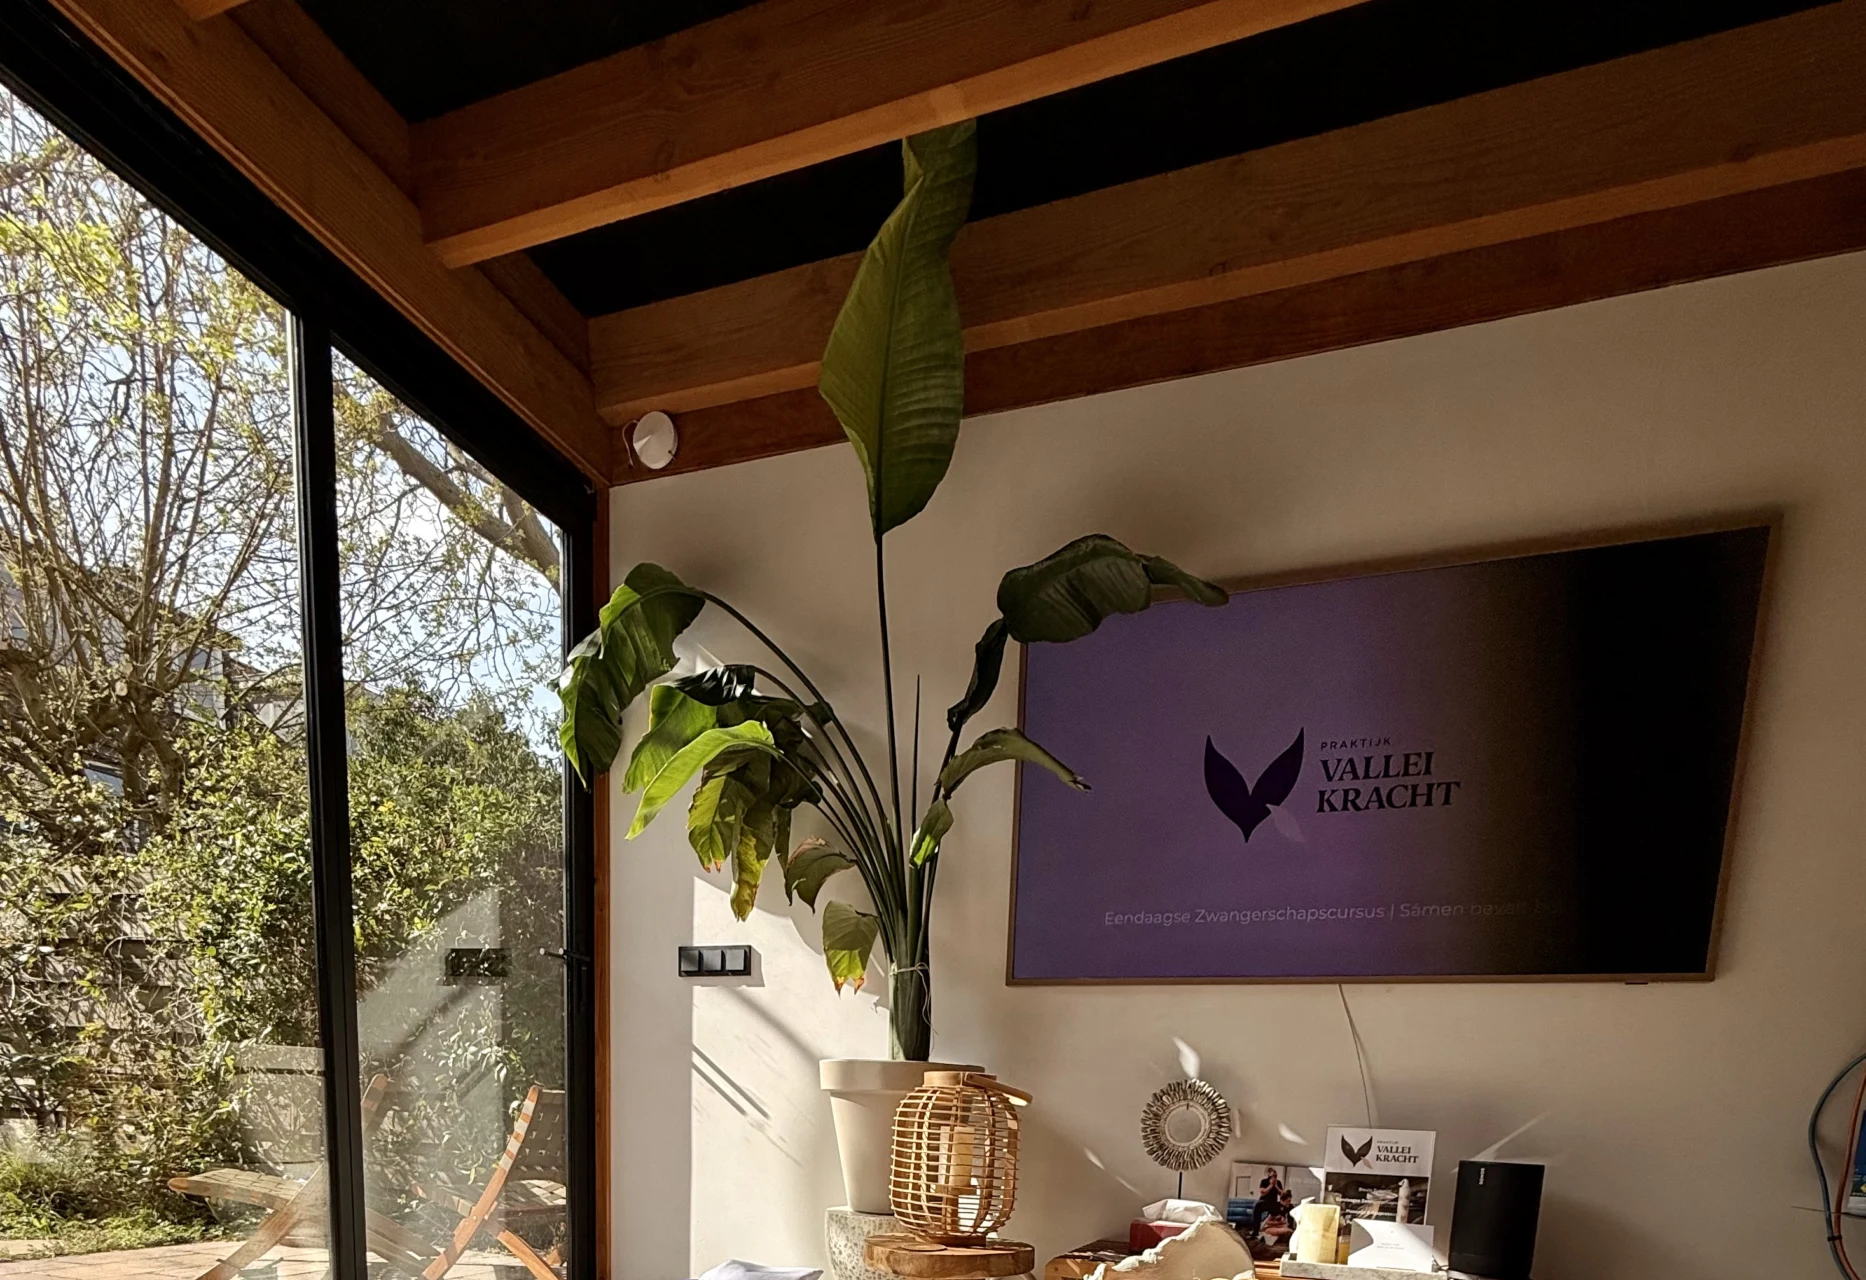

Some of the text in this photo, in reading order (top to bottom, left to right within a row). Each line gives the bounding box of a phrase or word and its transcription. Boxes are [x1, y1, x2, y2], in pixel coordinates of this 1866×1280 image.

[1320, 737, 1392, 750] PRAKTIJK
[1320, 752, 1434, 782] VALLEI
[1316, 781, 1461, 813] KRACHT
[1105, 910, 1191, 926] Eendaagse
[1195, 906, 1385, 924] Zwangerschapscursus
[1377, 1145, 1412, 1154] VALLEI
[1376, 1154, 1419, 1164] KRACHT
